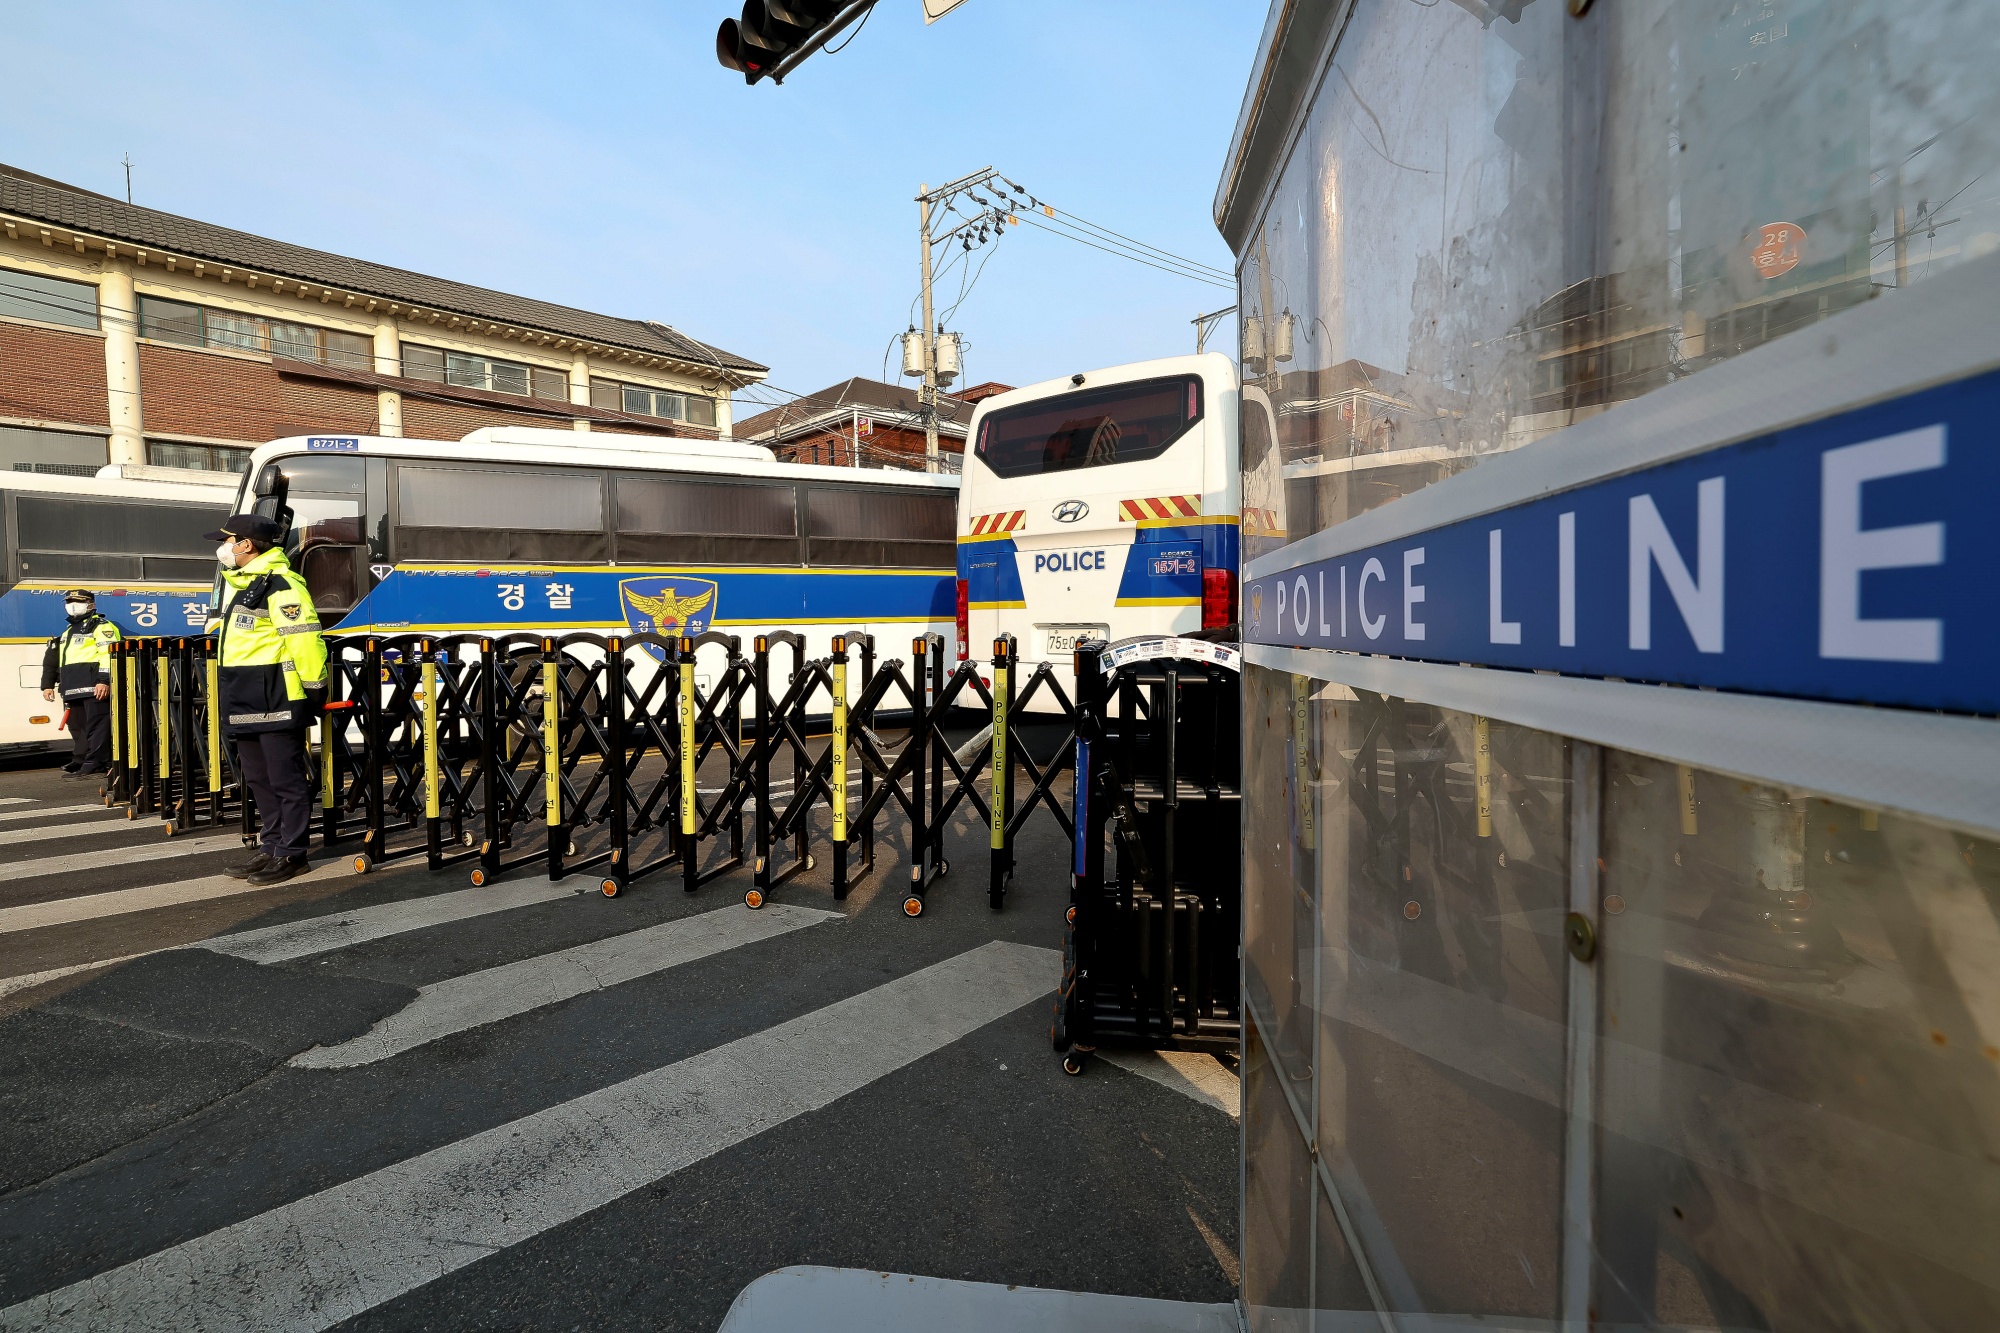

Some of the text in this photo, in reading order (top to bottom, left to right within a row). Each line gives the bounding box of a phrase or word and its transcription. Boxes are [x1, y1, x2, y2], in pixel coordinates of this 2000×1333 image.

[1755, 229, 1789, 250] 28
[313, 439, 354, 449] 87기-2
[1277, 423, 1947, 664] POLICE LINE
[1034, 550, 1106, 573] POLICE
[1154, 558, 1195, 575] 15기-2
[681, 694, 689, 761] POLICE
[994, 702, 1004, 830] POLICE LINE
